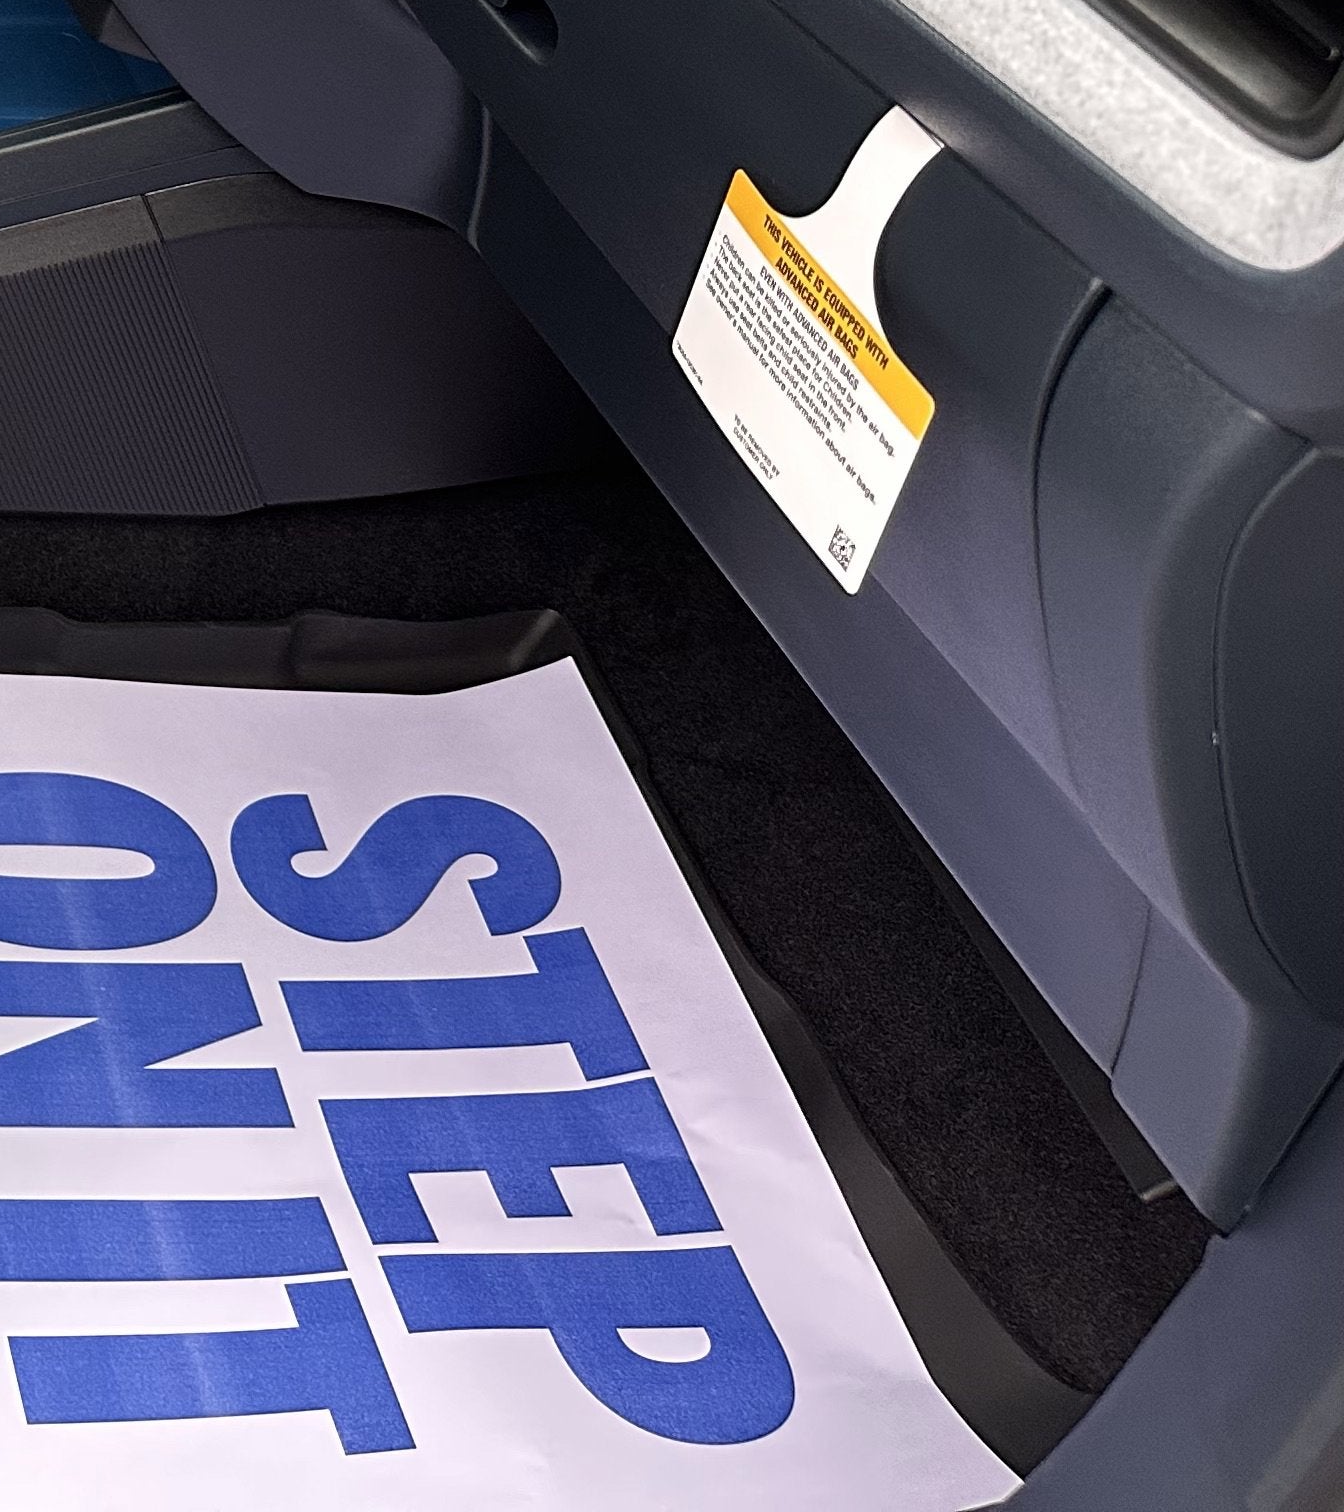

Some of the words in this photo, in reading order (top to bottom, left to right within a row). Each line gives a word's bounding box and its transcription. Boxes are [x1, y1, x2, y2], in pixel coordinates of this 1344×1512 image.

[759, 265, 777, 291] EVEN
[776, 286, 794, 312] WITH
[792, 307, 828, 352] ADVANCED
[826, 348, 841, 368] AIR
[839, 362, 859, 391] BAGS
[763, 213, 782, 243] THIS
[781, 235, 815, 283] VEHICLE
[812, 275, 825, 294] IS
[823, 286, 866, 342] EQUIPPED
[864, 334, 889, 370] WITH
[774, 256, 820, 312] ADVANCED
[817, 307, 836, 332] AIR
[833, 324, 859, 360] BAGS
[231, 794, 795, 1446] STEP
